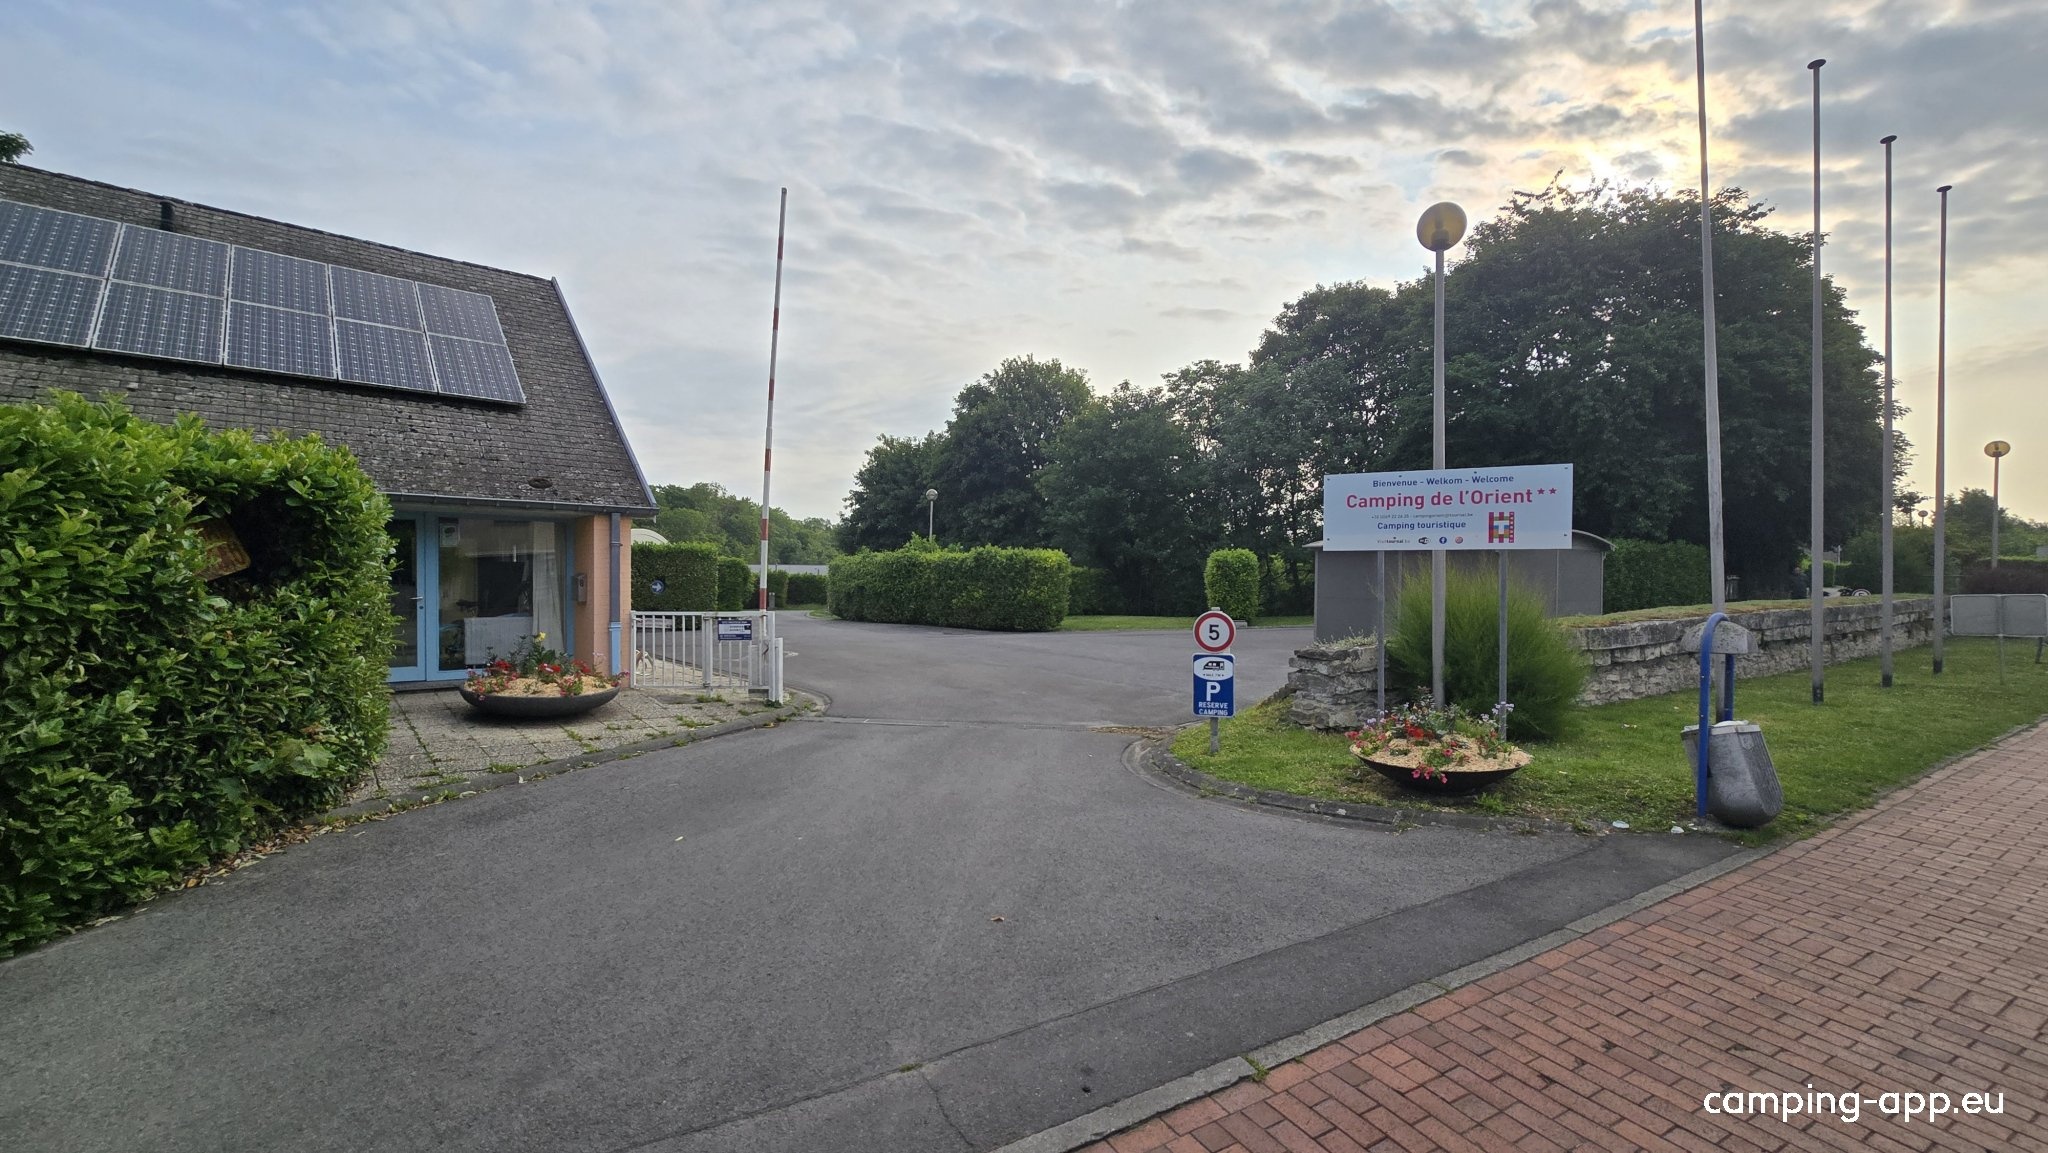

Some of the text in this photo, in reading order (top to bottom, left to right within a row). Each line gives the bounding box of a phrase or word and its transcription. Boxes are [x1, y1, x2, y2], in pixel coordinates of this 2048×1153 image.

[1426, 477, 1463, 485] Welkom
[1471, 475, 1514, 483] Welcome
[1346, 489, 1533, 510] Camping de l'Orient
[1377, 520, 1466, 530] Camping touristique
[1208, 624, 1219, 640] 5
[1206, 681, 1221, 701] P
[1198, 701, 1229, 709] RESERVE
[1198, 708, 1229, 716] CAMPING
